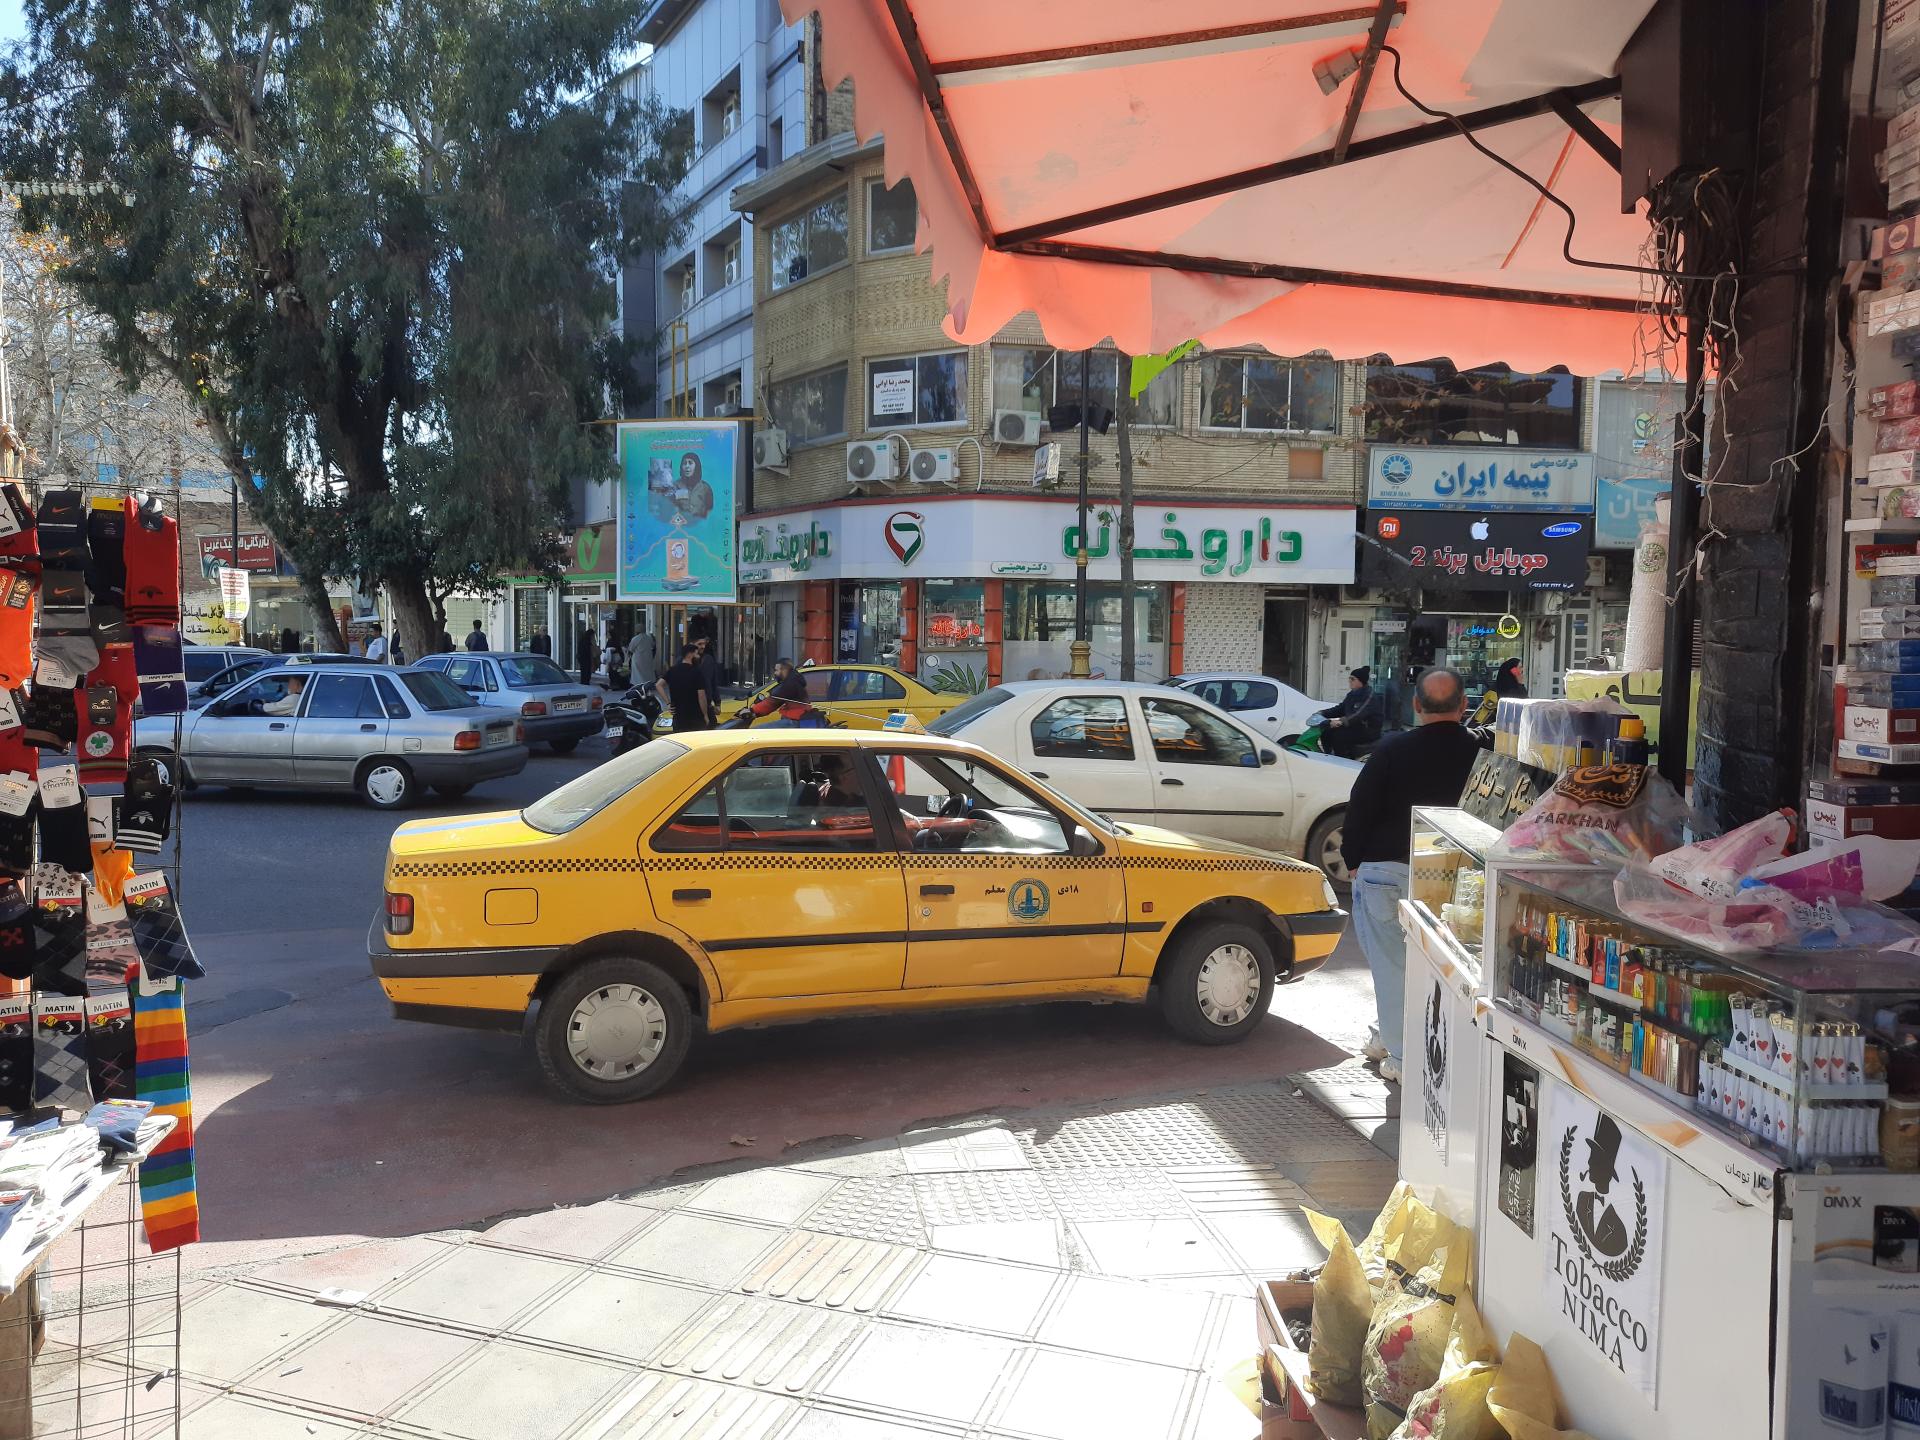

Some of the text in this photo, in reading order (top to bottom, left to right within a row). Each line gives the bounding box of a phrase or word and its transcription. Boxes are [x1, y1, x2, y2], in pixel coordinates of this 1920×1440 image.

[1434, 459, 1551, 499] بیمه ایران
[1548, 525, 1577, 534] SAMSUNG
[245, 536, 270, 551] بازرگانی
[742, 520, 833, 572] داروخانه
[1062, 511, 1304, 578] داروخنه
[1026, 562, 1047, 573] دکتر
[1411, 545, 1549, 577] موبایل برند 2
[931, 620, 982, 643] داروخانه
[1853, 716, 1880, 730] بهمن
[1534, 811, 1620, 833] FARKHAN
[1813, 810, 1837, 827] بهمن
[130, 879, 160, 894] MATIN
[984, 884, 1006, 897] معلم
[0, 1004, 23, 1015] ATIN
[44, 1004, 76, 1013] MATIN
[93, 1000, 124, 1013] MATIN
[1422, 1068, 1446, 1130] Tobacco
[1725, 1162, 1752, 1184] تومان
[1507, 1170, 1515, 1216] LET'S
[1513, 1167, 1521, 1220] CAMEL
[1550, 1231, 1649, 1354] Tobacco
[1561, 1283, 1626, 1375] NIMA
[1823, 1384, 1858, 1423] Winston
